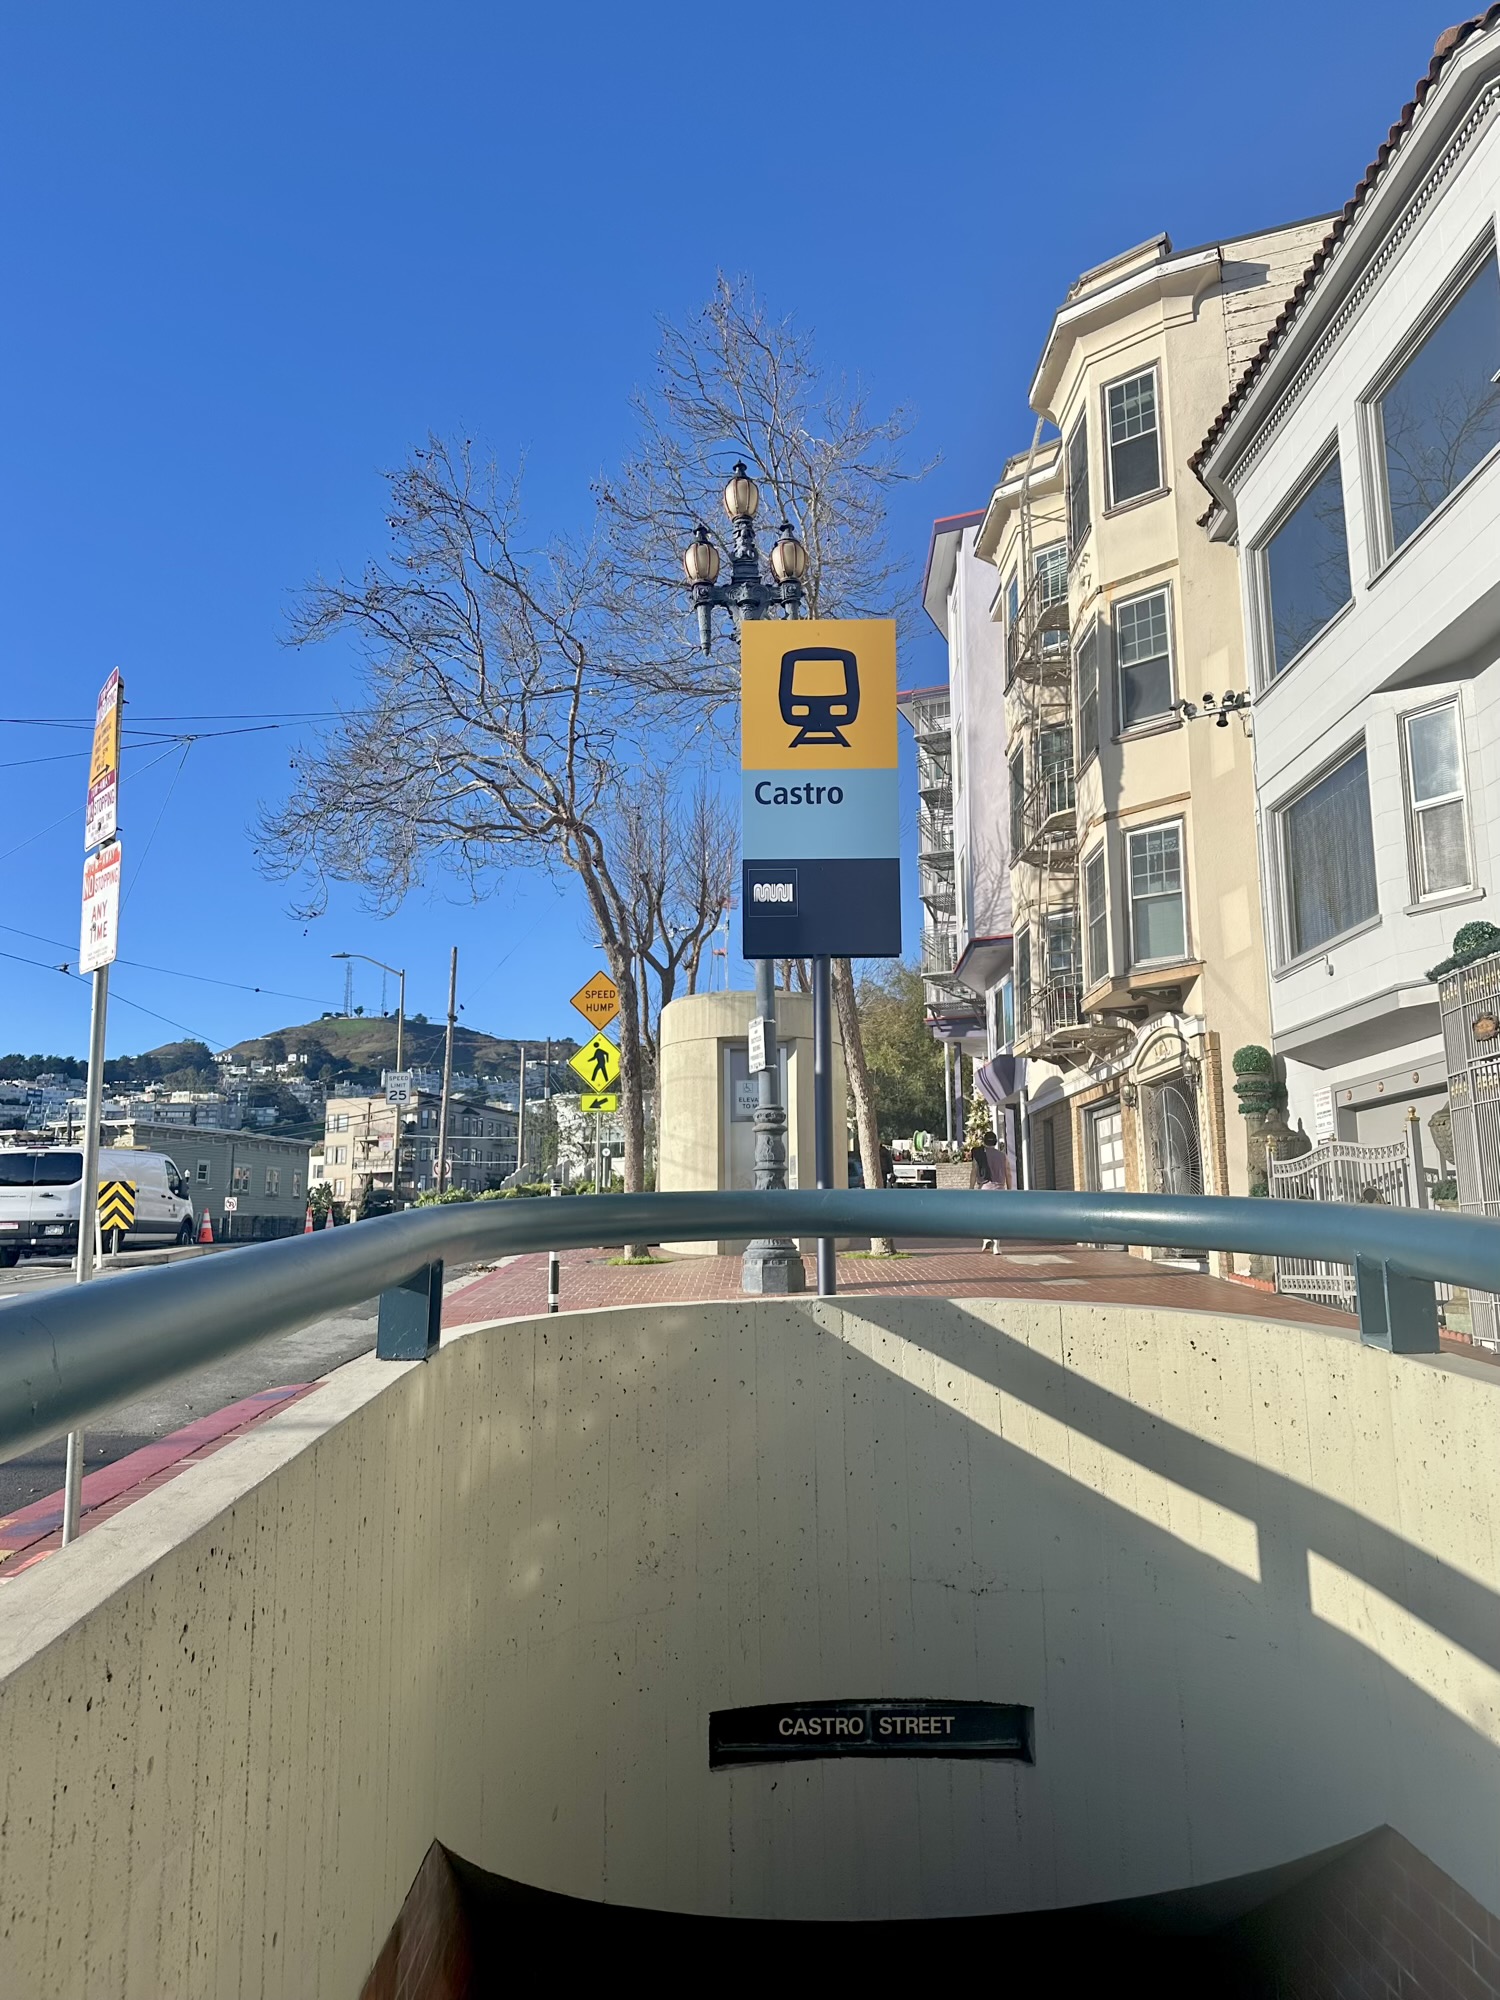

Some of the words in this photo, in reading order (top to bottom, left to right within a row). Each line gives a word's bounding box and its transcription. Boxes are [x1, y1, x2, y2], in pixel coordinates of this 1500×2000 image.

[754, 781, 844, 806] Castro
[94, 867, 119, 893] STOPPING
[91, 899, 108, 922] ANY
[90, 920, 108, 944] TIME
[585, 990, 616, 999] SPEED
[586, 1003, 614, 1012] HUMP
[389, 1090, 407, 1101] 25
[778, 1716, 864, 1736] CASTRO
[878, 1716, 956, 1735] STREET
